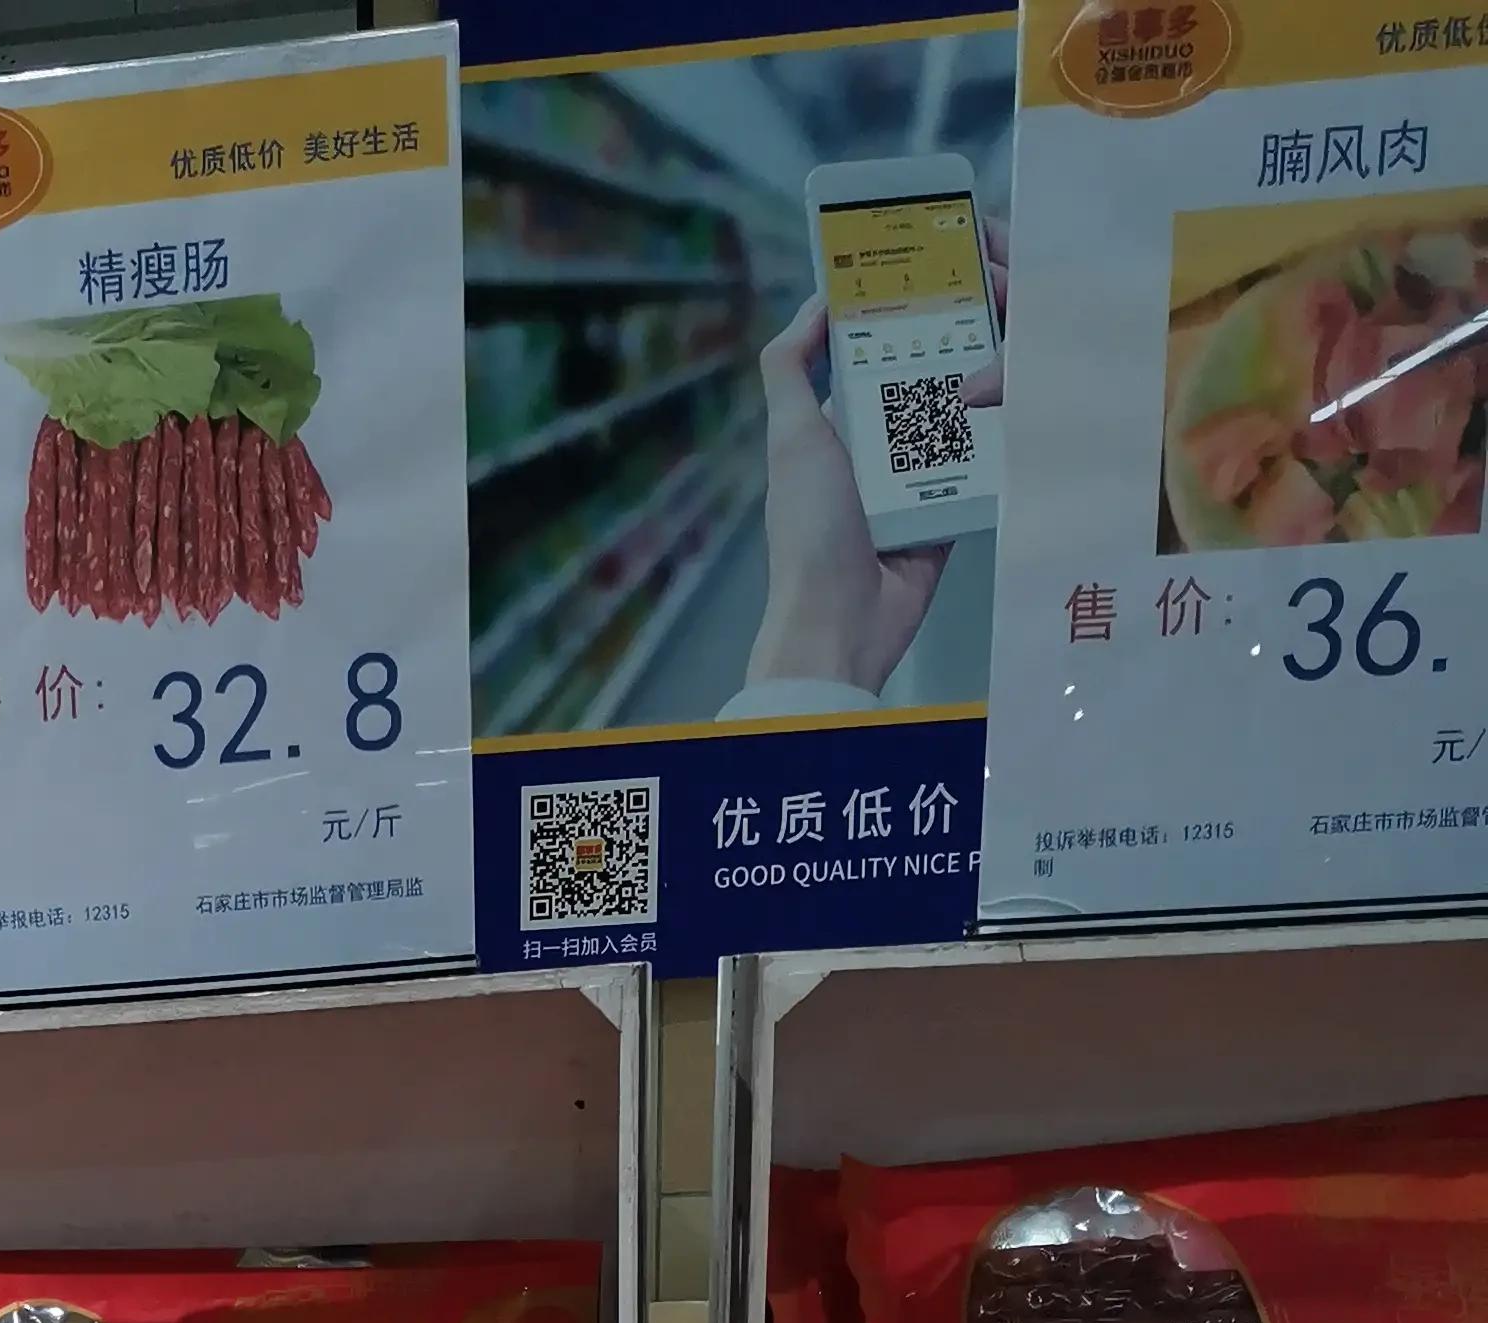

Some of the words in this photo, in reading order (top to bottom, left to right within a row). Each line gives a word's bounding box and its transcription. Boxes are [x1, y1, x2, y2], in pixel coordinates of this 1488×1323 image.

[169, 138, 284, 180] 优质低价
[302, 122, 420, 166] 美好生活
[1258, 119, 1430, 188] 腩风肉
[79, 238, 230, 305] 精瘦肠
[152, 652, 402, 769] 32.8
[321, 804, 402, 843] 元/斤
[713, 782, 959, 850] 优质低价
[196, 876, 425, 915] 石家庄市市场监督管理局监
[714, 864, 786, 889] GOOD
[793, 856, 898, 888] QUALITY
[904, 852, 961, 877] NICE
[522, 930, 659, 961] 扫一扫加入会员
